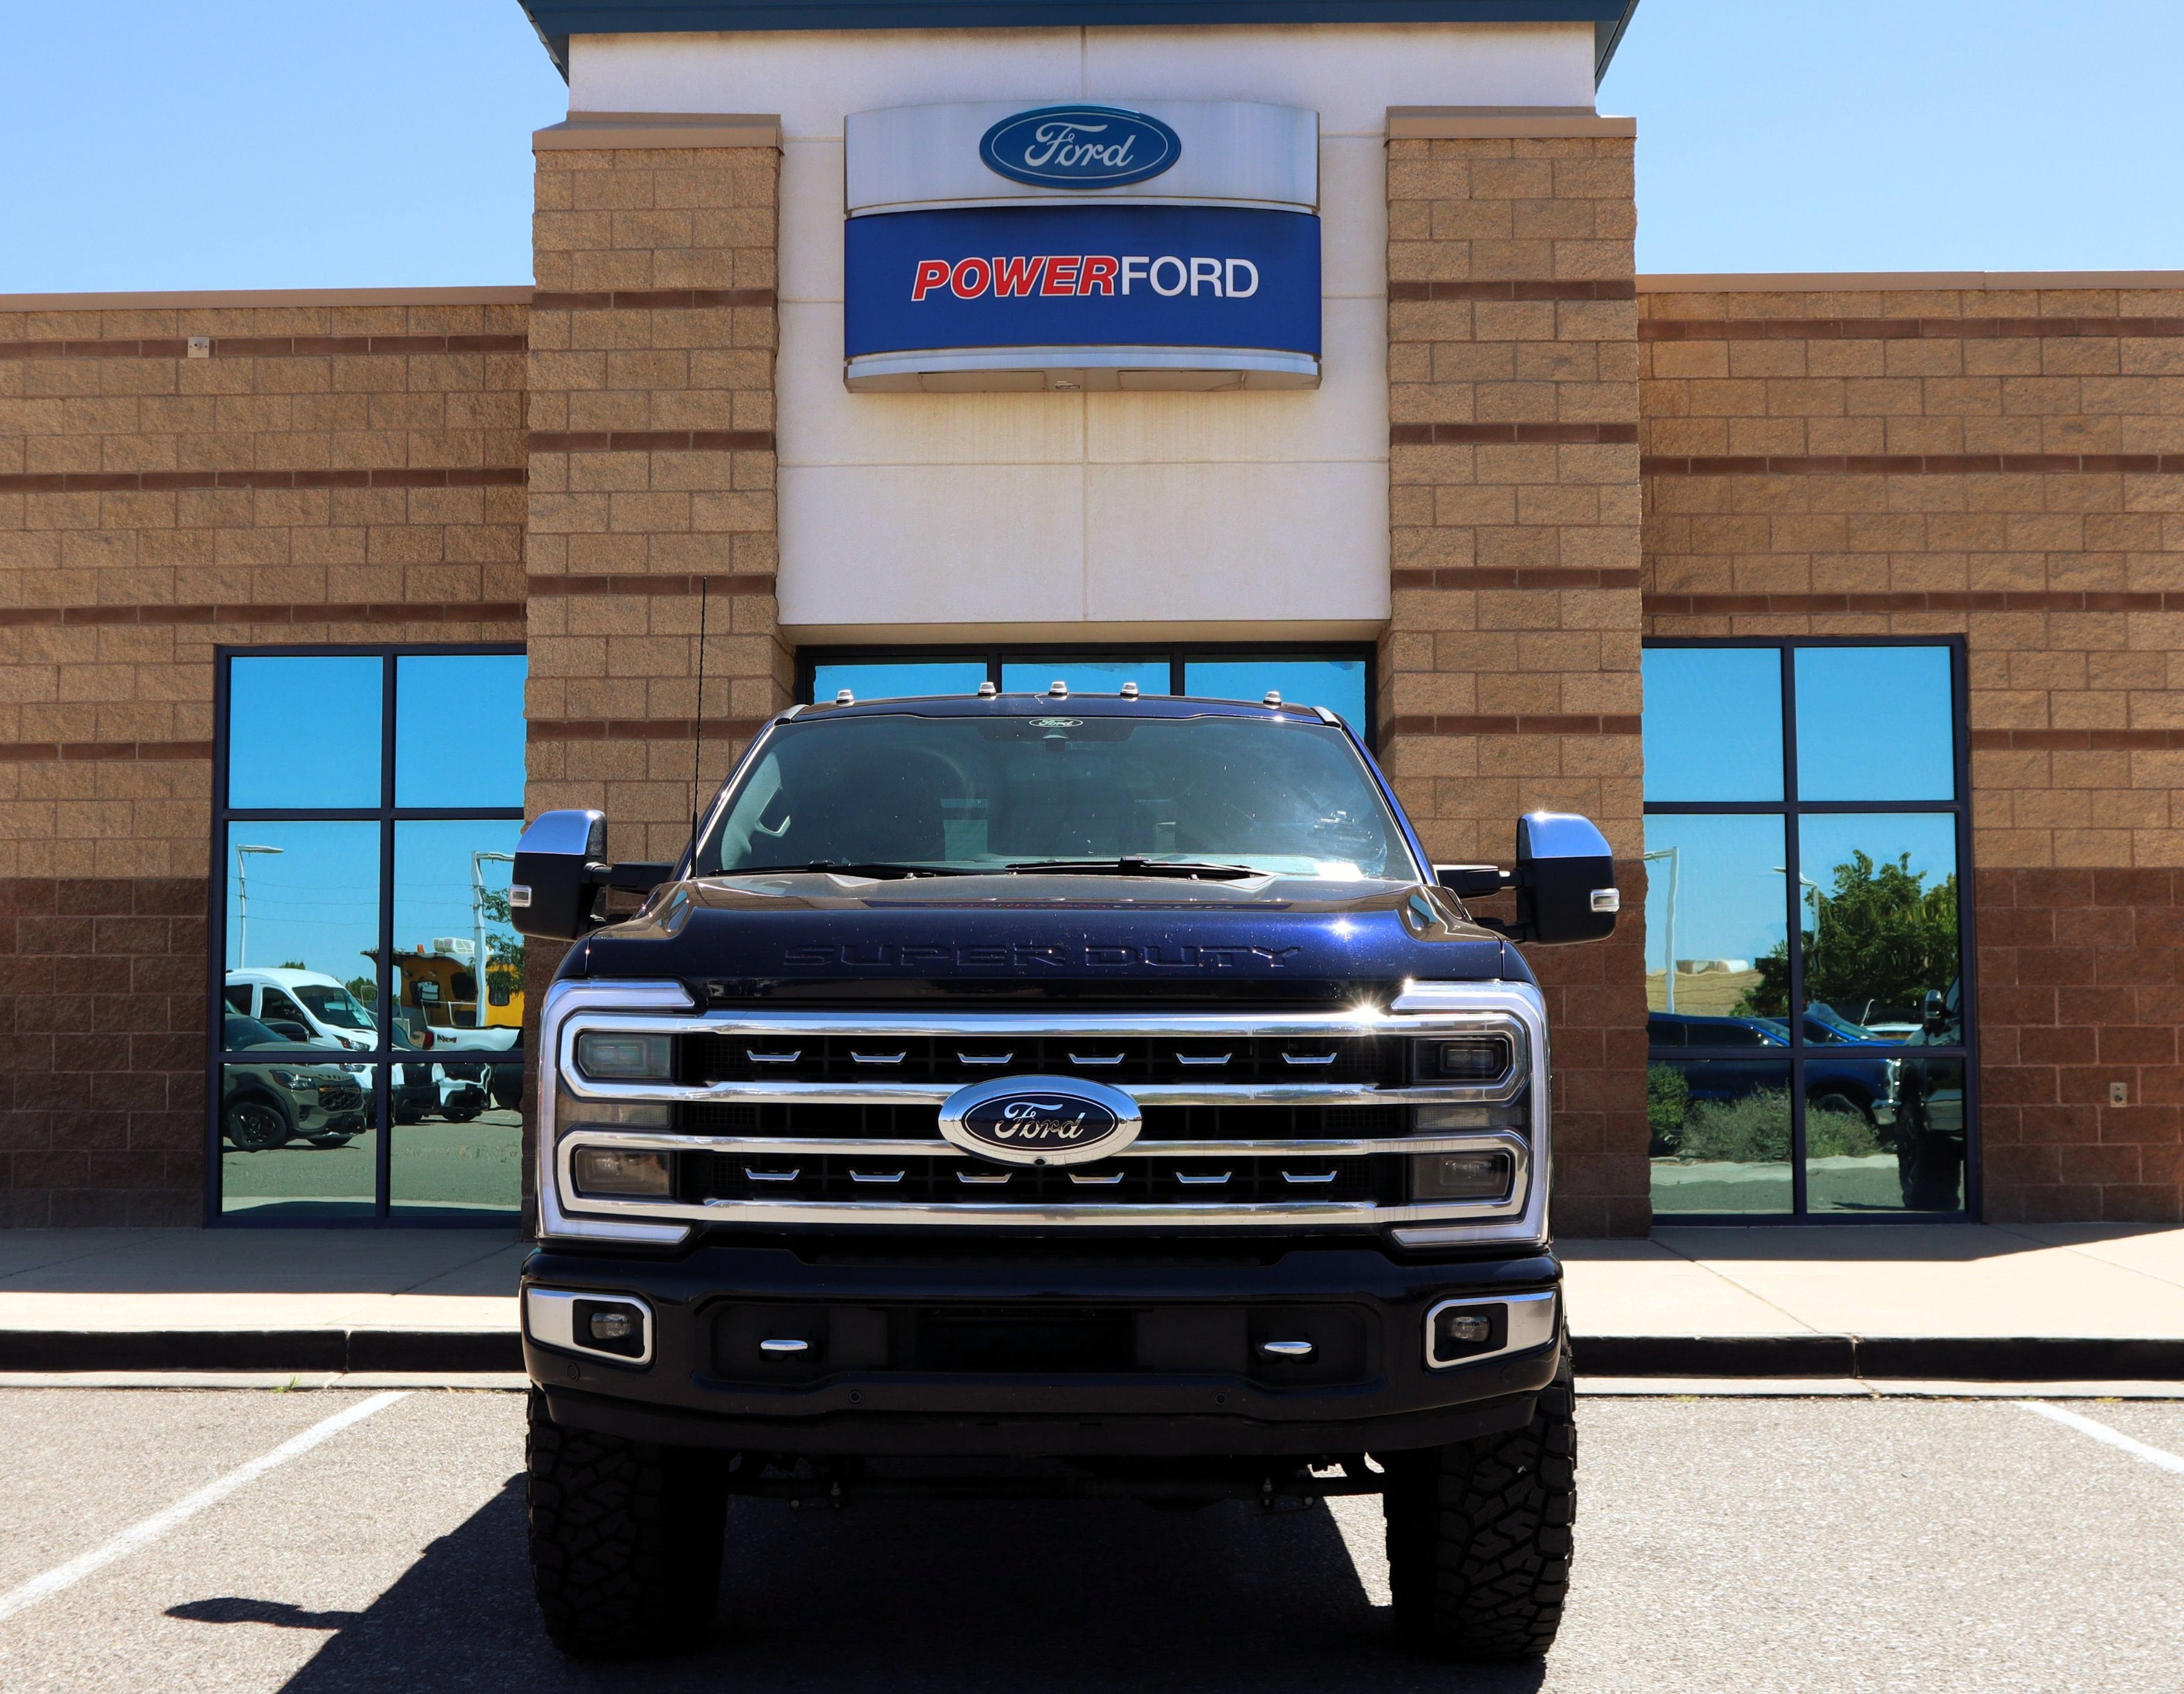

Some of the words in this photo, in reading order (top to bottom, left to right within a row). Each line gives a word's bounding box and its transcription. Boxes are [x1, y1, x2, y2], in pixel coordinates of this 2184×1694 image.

[1024, 122, 1136, 167] Ford
[783, 945, 1065, 967] SUPER
[1085, 945, 1302, 967] DUTY
[995, 1102, 1086, 1139] Ford
